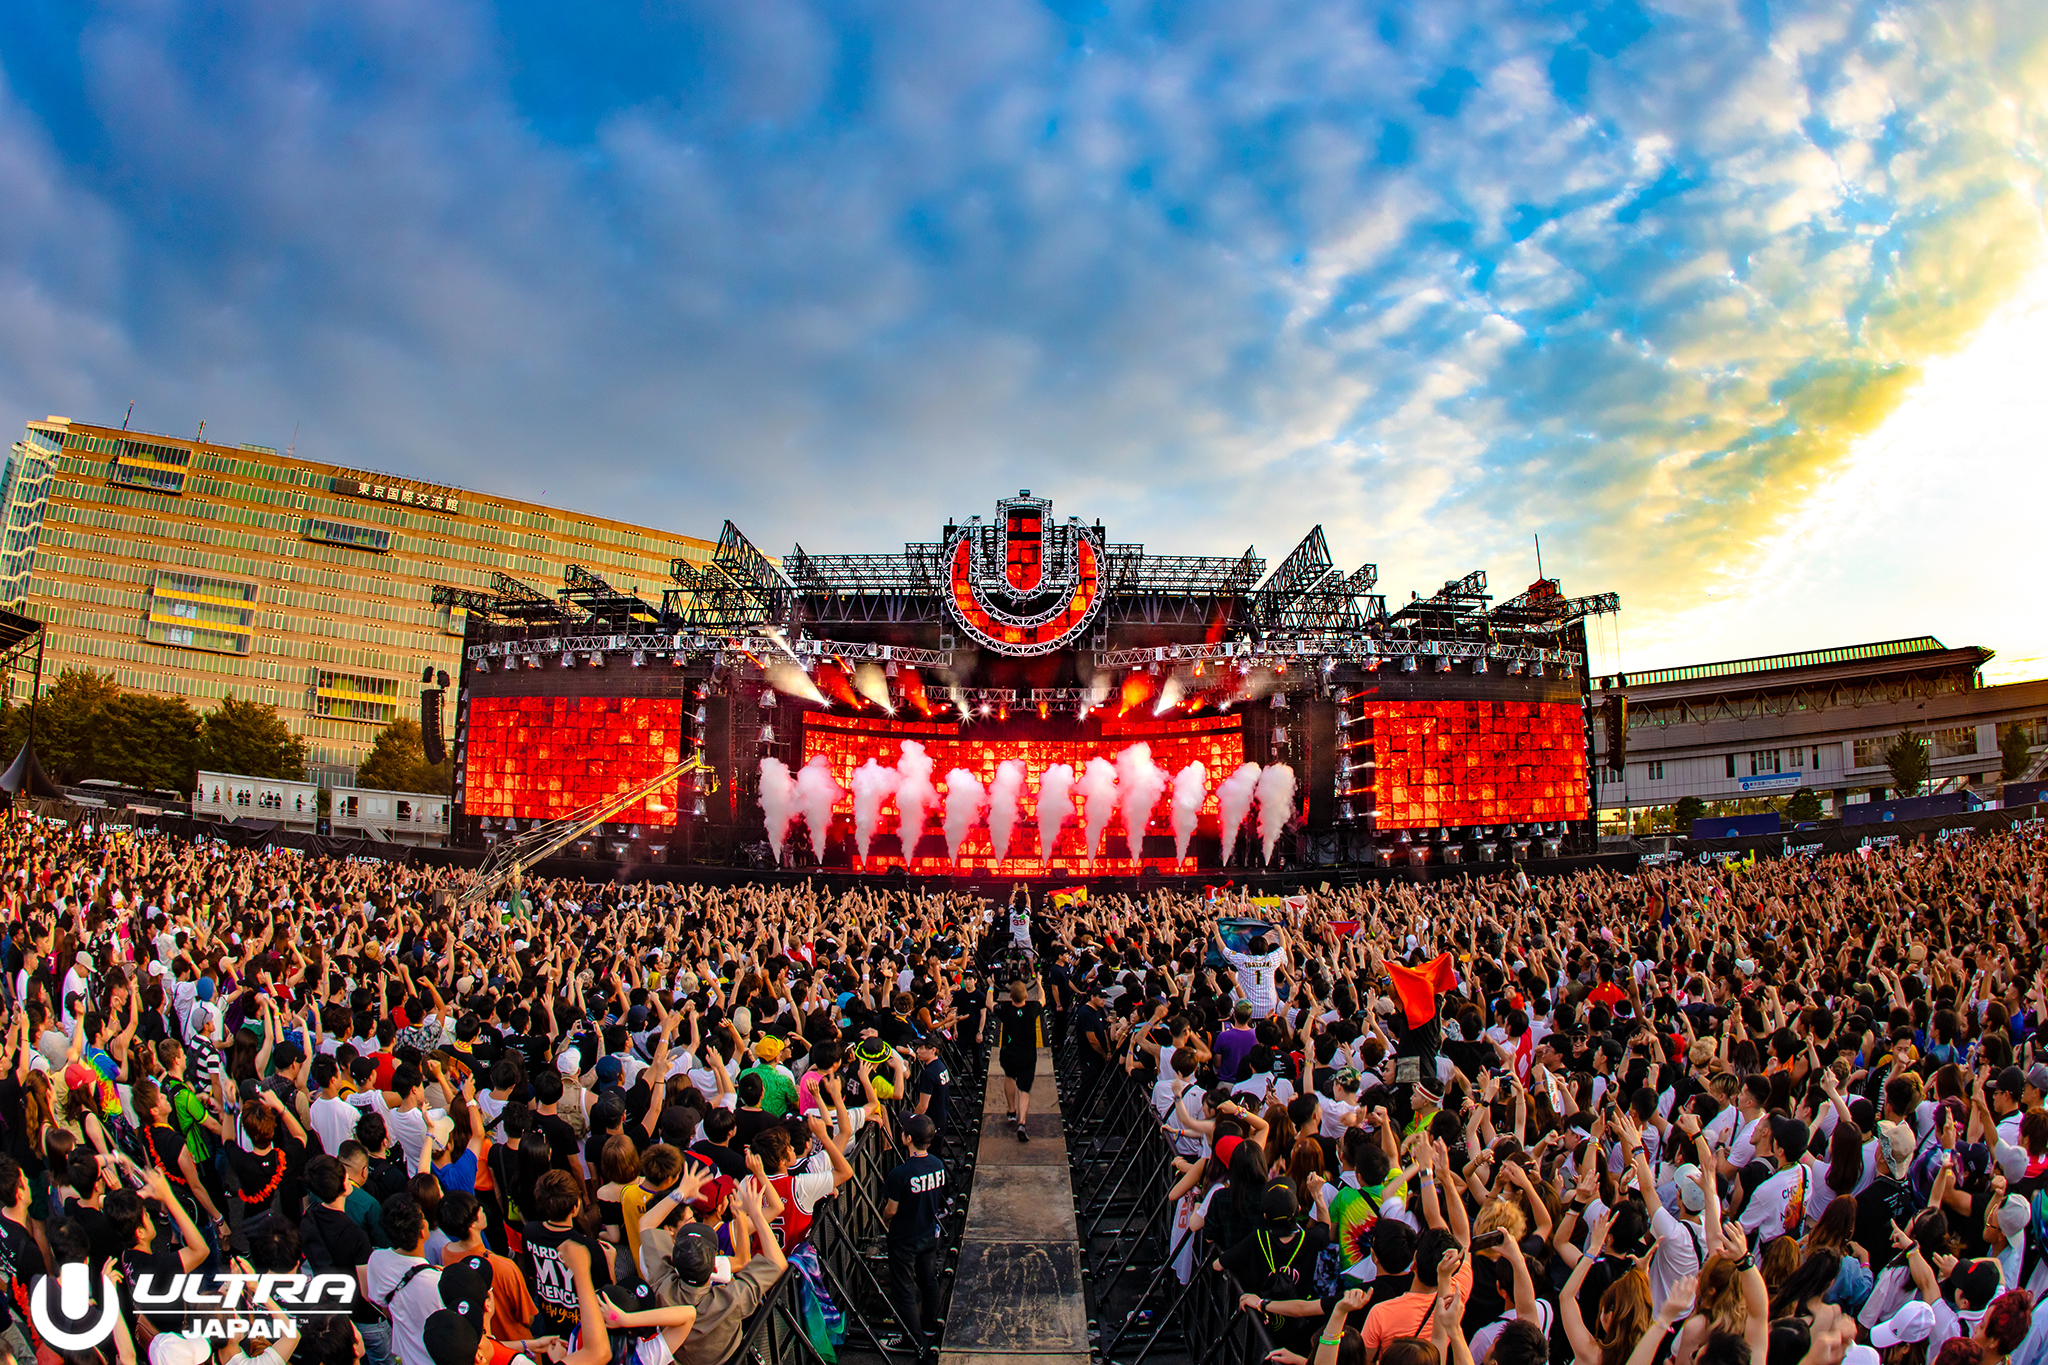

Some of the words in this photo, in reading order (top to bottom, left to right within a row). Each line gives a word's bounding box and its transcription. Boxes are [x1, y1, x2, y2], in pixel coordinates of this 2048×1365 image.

[357, 481, 460, 512] 東京国際交流館
[1254, 969, 1262, 986] 1
[532, 1253, 575, 1292] MY
